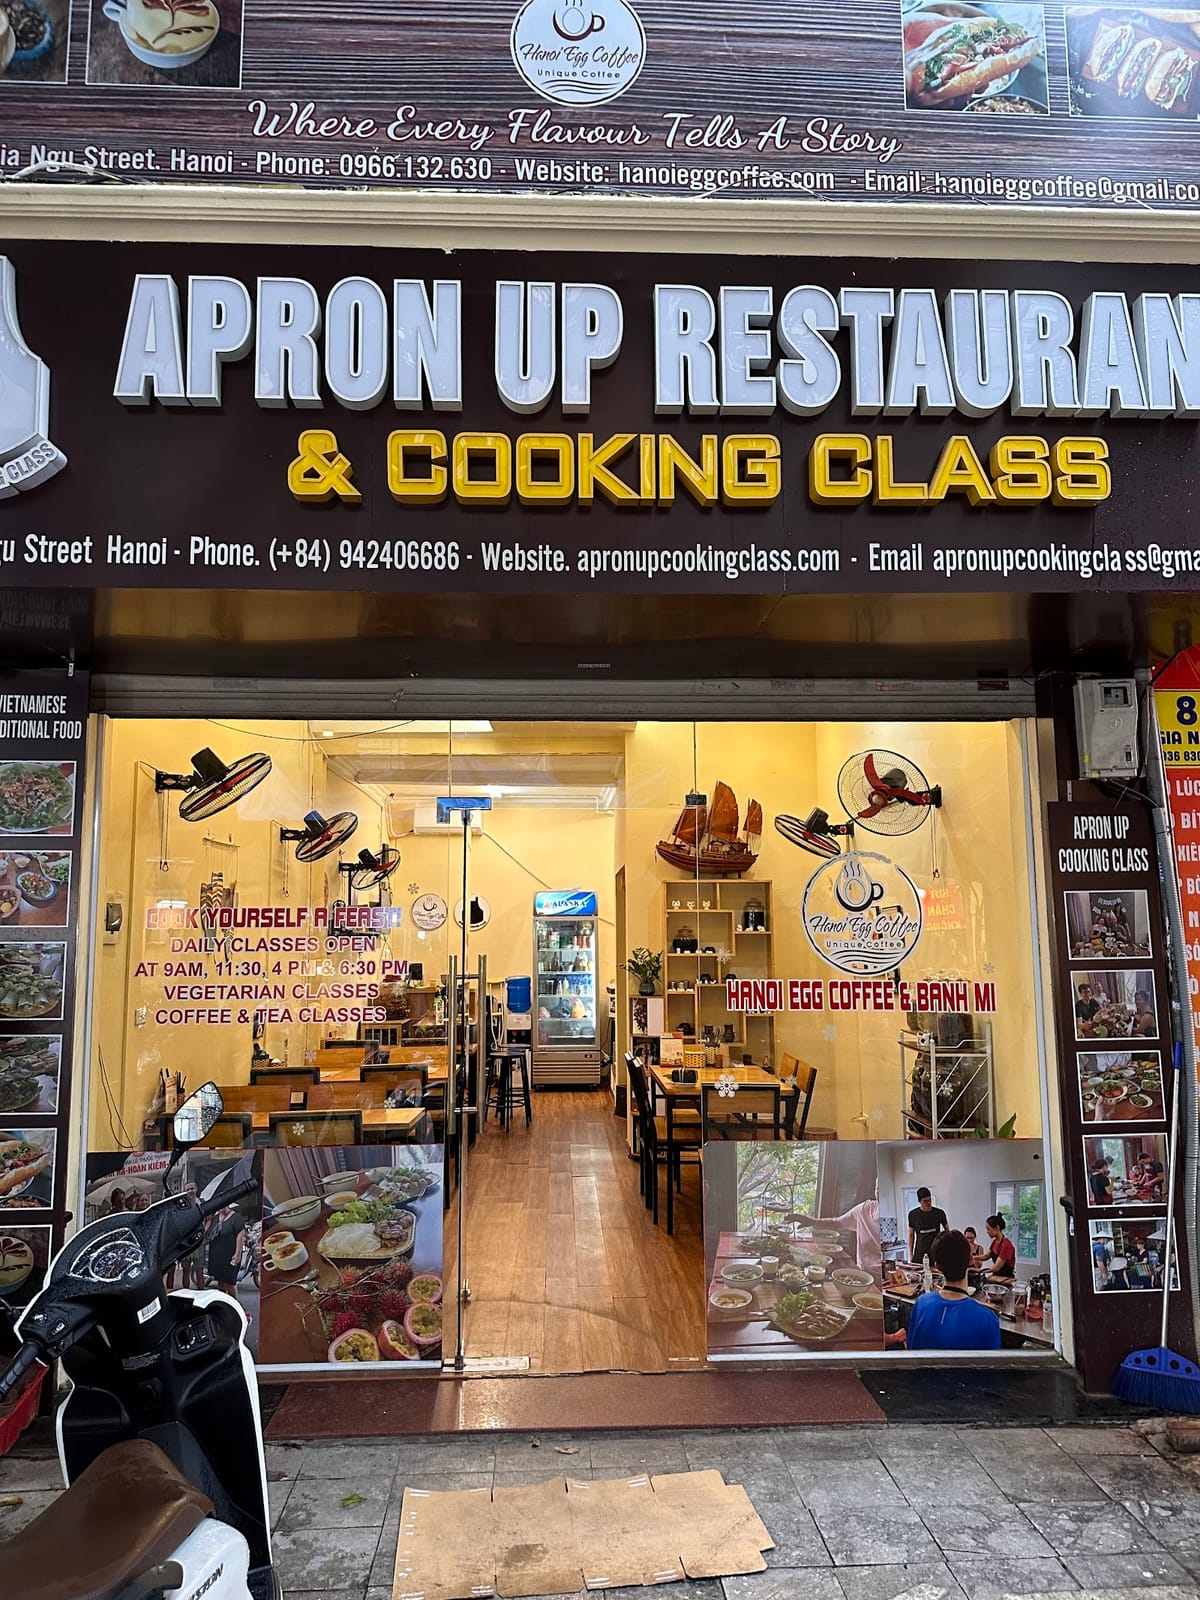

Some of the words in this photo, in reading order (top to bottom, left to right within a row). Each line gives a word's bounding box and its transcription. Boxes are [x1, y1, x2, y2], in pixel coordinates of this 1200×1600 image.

[520, 43, 562, 61] Hanoi
[564, 46, 589, 68] Egg
[592, 46, 639, 68] Coffee
[537, 69, 577, 78] Unique
[582, 70, 620, 78] Coffee
[248, 100, 377, 137] Where
[386, 105, 495, 150] Every
[508, 108, 650, 146] Flavour
[662, 112, 748, 149] Tells
[757, 116, 790, 151] A
[802, 117, 903, 163] Story
[31, 145, 74, 172] Ngu
[83, 145, 161, 171] Street.
[170, 148, 233, 173] Hanoi
[256, 151, 331, 175] Phone:
[339, 153, 492, 180] 0966.132.630
[514, 158, 610, 183] Website:
[618, 162, 835, 190] hanoieggcoffee.com
[864, 169, 927, 194] Email:
[113, 274, 463, 410] APRON
[495, 279, 623, 415] UP
[654, 284, 1200, 419] RESTAURAN
[6, 442, 56, 482] CLASS
[288, 429, 361, 502] &
[387, 429, 781, 507] COOKING
[809, 433, 1112, 507] CLASS
[24, 533, 93, 564] Street
[107, 535, 168, 565] Hanoi
[189, 536, 260, 566] Phone.
[269, 537, 331, 572] (+84)
[339, 540, 460, 570] 942406686
[481, 542, 570, 571] Website.
[577, 543, 840, 579] apronupcookingclass.com
[869, 542, 923, 571] Email
[53, 720, 82, 739] FOOD
[1074, 815, 1111, 839] APRON
[1115, 815, 1129, 839] UP
[1059, 848, 1109, 872] COOKING
[1112, 847, 1149, 871] CLASS
[146, 908, 199, 928] COOK
[206, 907, 307, 929] YOURSELF
[314, 907, 327, 928] A
[809, 915, 848, 933] Hanoi
[849, 917, 872, 939] Egg
[875, 915, 919, 938] Coffee
[171, 937, 224, 953] DAILY
[231, 937, 318, 952] CLASSES
[324, 936, 376, 952] OPEN
[825, 940, 862, 949] Unique
[865, 940, 902, 949] Coffee
[134, 962, 158, 977] AT
[164, 962, 208, 979] 9AM,
[215, 961, 267, 979] 11:30,
[272, 961, 282, 976] 4
[288, 960, 316, 976] PM
[321, 960, 336, 976] &
[340, 960, 376, 975] 6:30
[381, 959, 409, 975] PM
[164, 984, 286, 1001] VEGETARIAN
[292, 983, 380, 999] CLASSES
[726, 979, 783, 1011] HANOI
[789, 980, 823, 1011] EGG
[829, 980, 895, 1012] COFFEE
[900, 981, 912, 1012] &
[916, 981, 968, 1012] BANH
[974, 982, 996, 1012] MI
[155, 1008, 231, 1024] COFFEE
[237, 1008, 250, 1024] &
[255, 1007, 293, 1023] TEA
[299, 1006, 387, 1022] CLASSES
